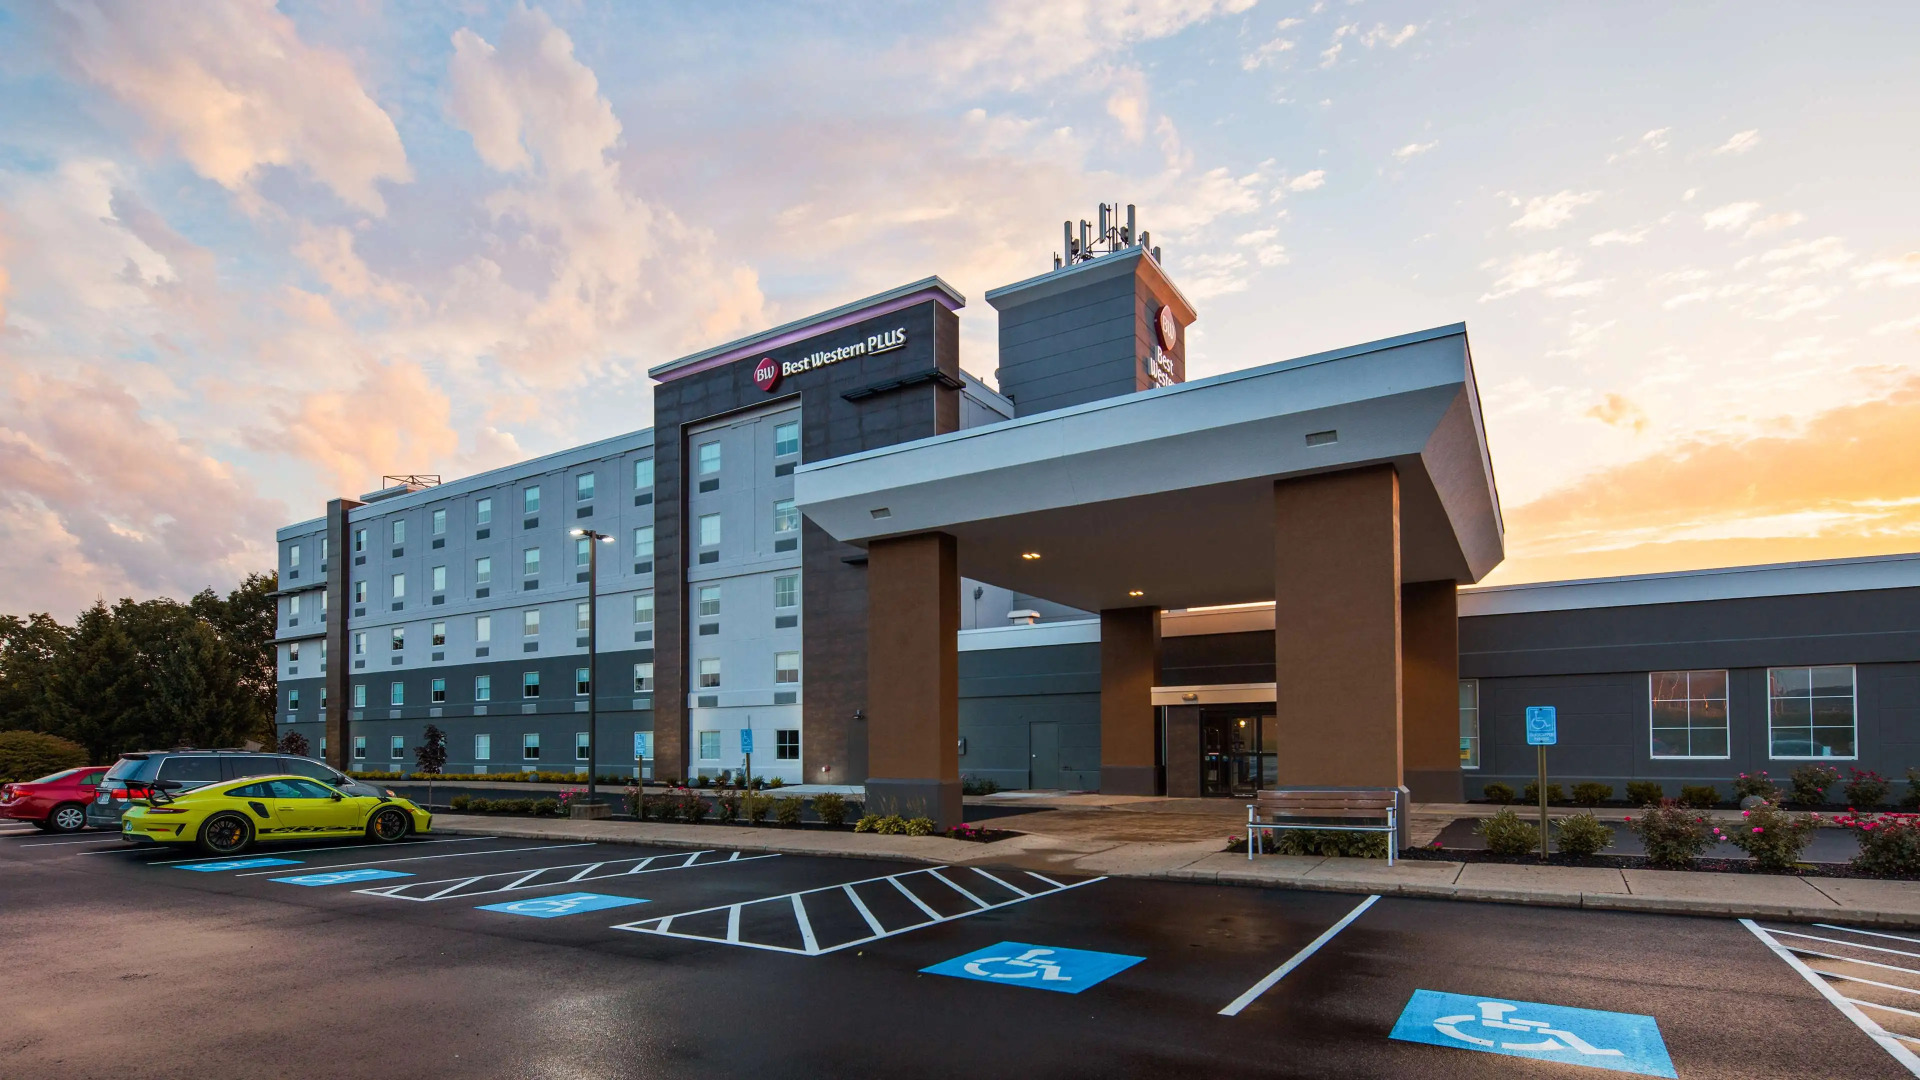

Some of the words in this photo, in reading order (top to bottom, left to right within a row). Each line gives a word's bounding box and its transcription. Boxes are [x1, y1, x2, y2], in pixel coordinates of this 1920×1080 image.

[1162, 315, 1175, 340] BW
[782, 357, 811, 377] Best
[811, 342, 865, 368] Western
[867, 327, 907, 351] PLUS
[1157, 345, 1174, 376] Best
[756, 365, 775, 382] BW
[1150, 357, 1175, 387] Weste
